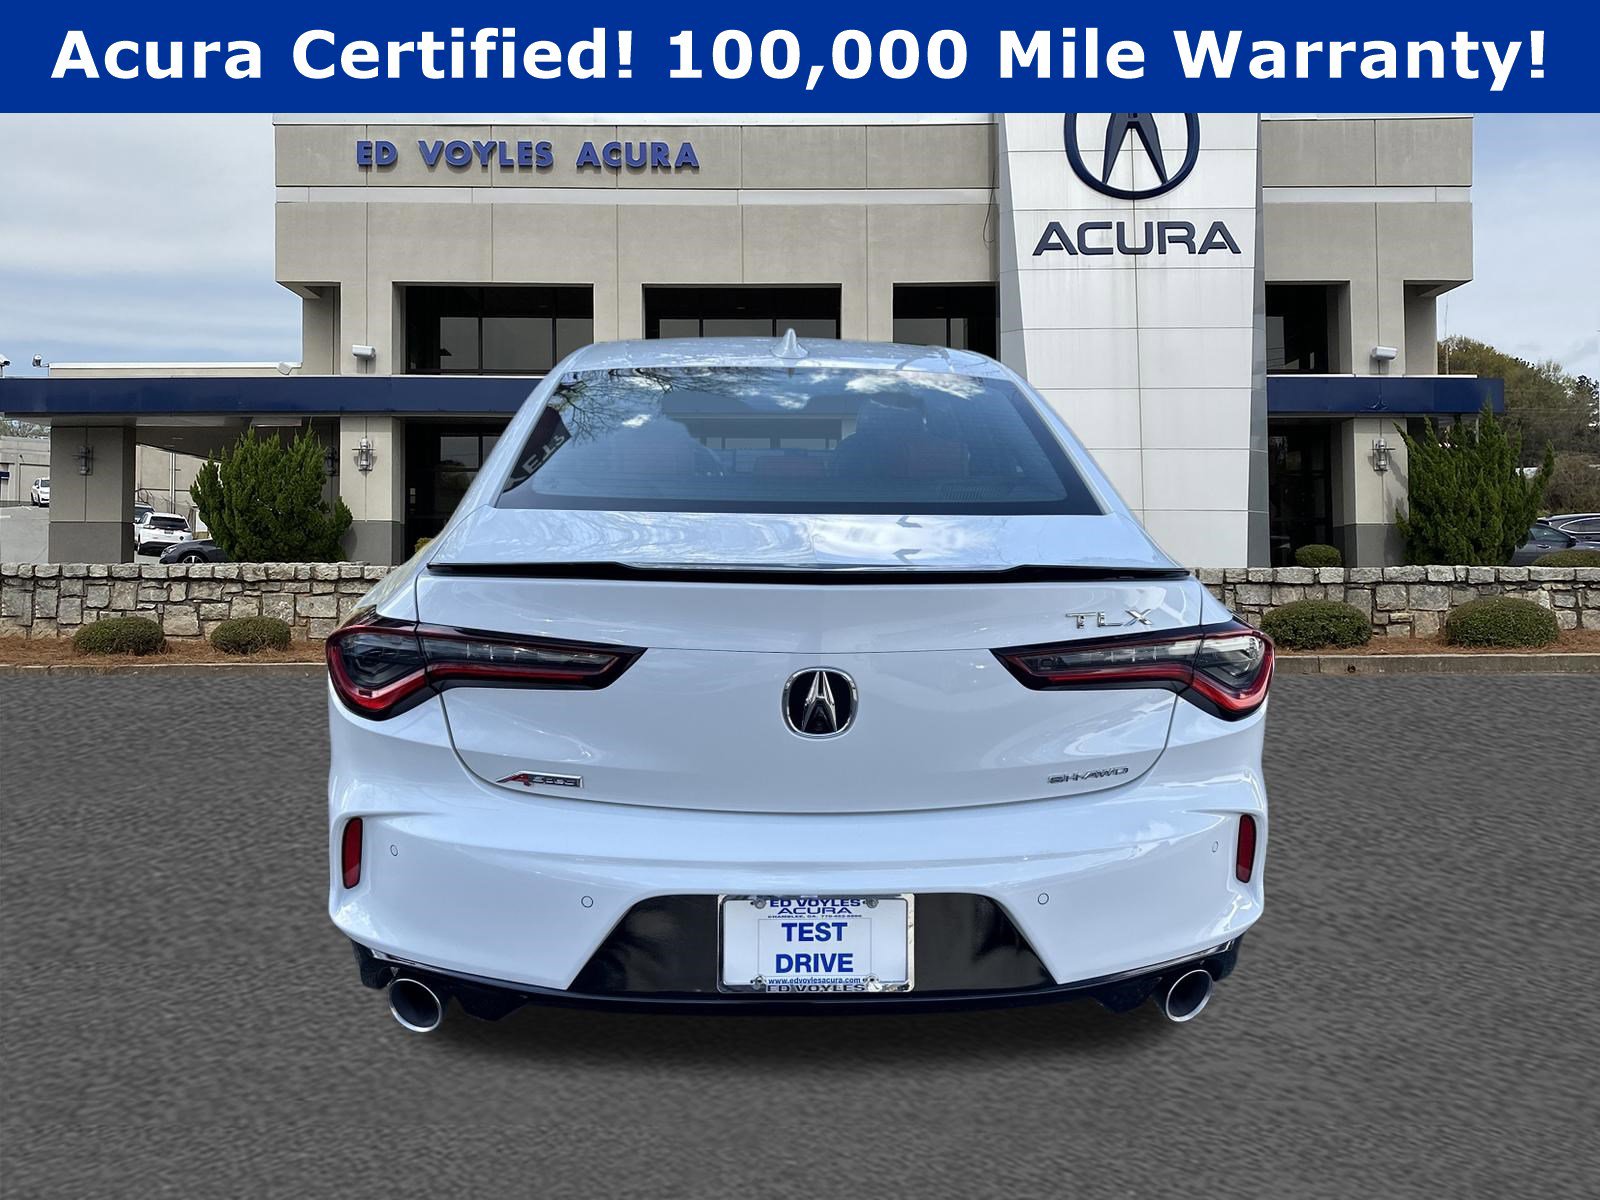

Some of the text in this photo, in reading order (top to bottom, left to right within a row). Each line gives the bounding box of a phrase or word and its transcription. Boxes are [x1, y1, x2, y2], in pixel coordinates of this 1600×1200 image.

[356, 140, 700, 168] ED VOYLES ACURA
[1032, 221, 1242, 256] ACURA
[1065, 608, 1153, 629] TLX
[770, 899, 861, 908] ED VOYLES
[781, 922, 848, 942] TEST
[775, 953, 854, 973] DRIVE
[767, 984, 866, 992] ED VOYLES
